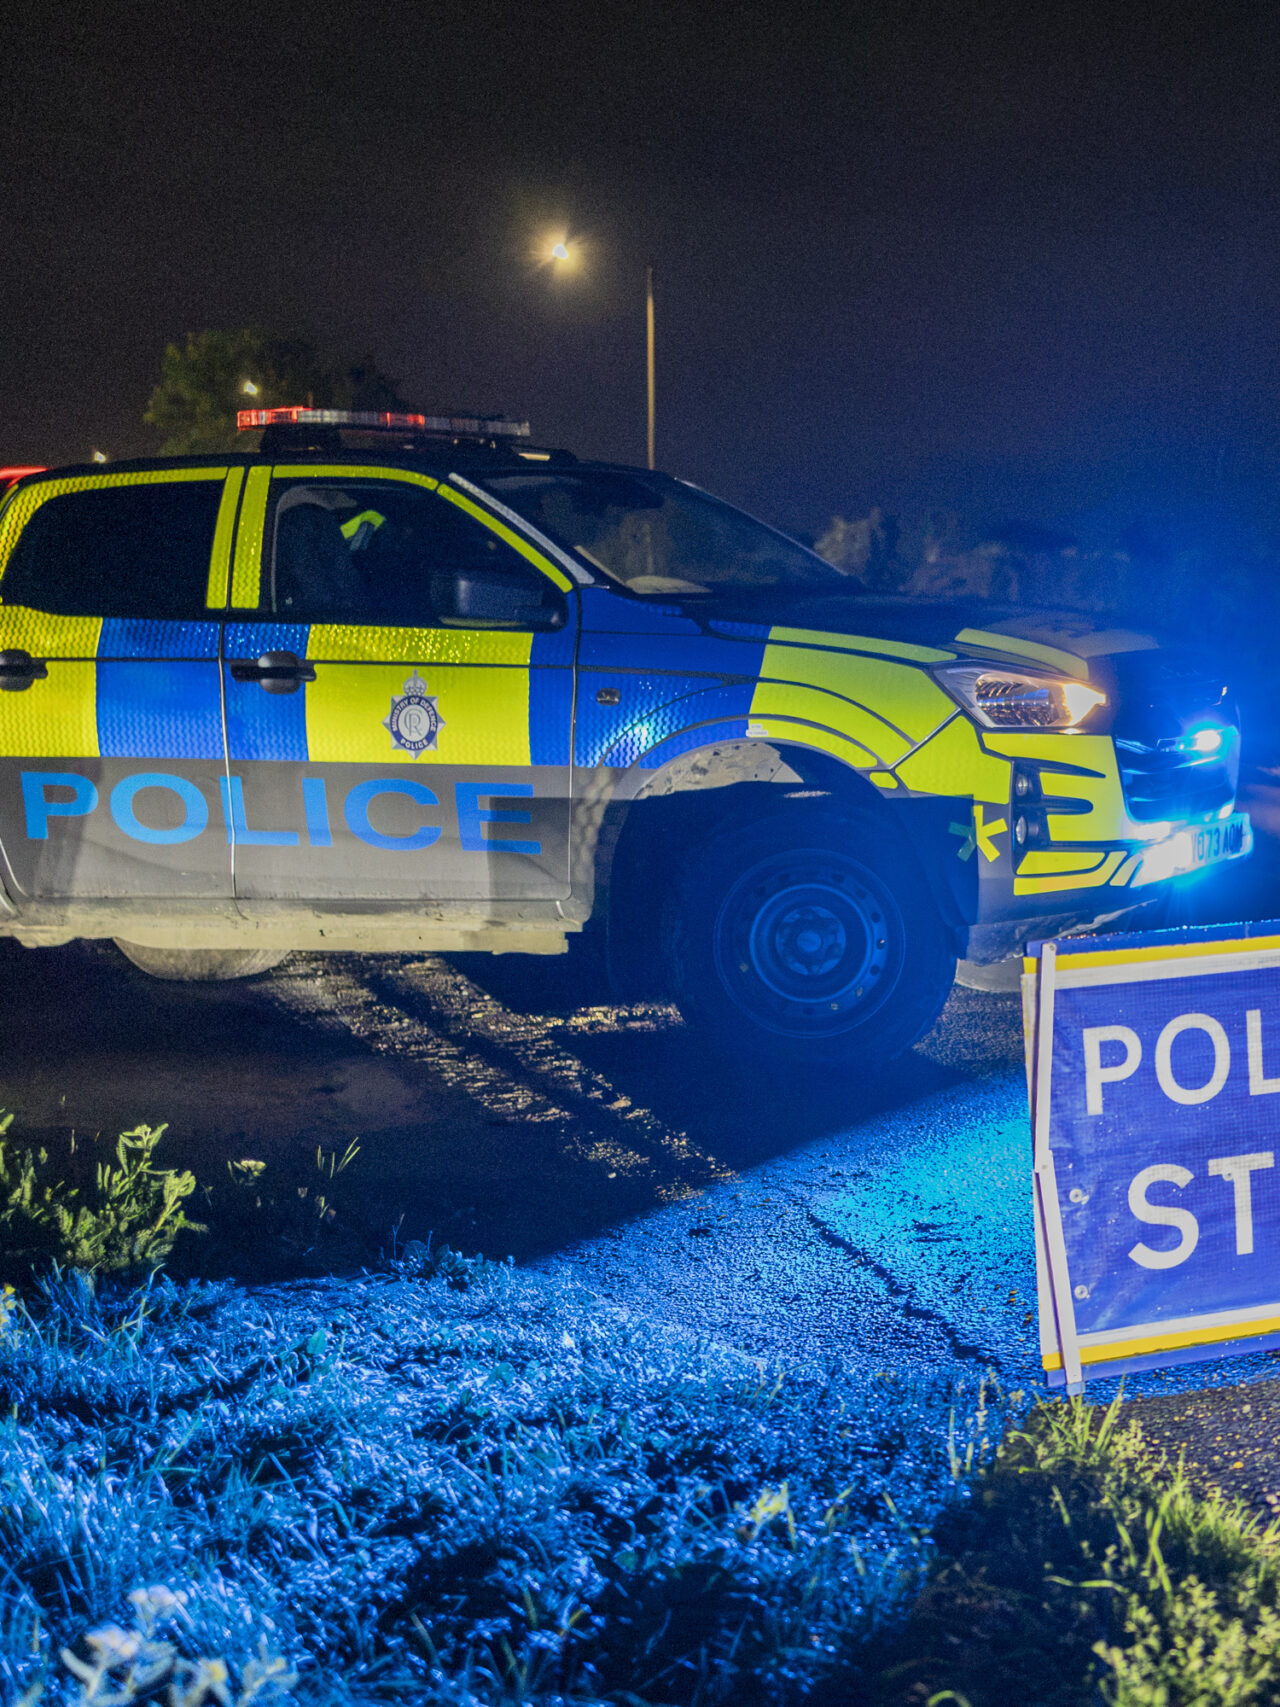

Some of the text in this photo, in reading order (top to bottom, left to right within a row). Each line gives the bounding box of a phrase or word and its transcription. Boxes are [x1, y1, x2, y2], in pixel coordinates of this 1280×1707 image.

[409, 697, 420, 705] OF
[401, 738, 428, 750] POLICE
[20, 771, 542, 855] POLICE
